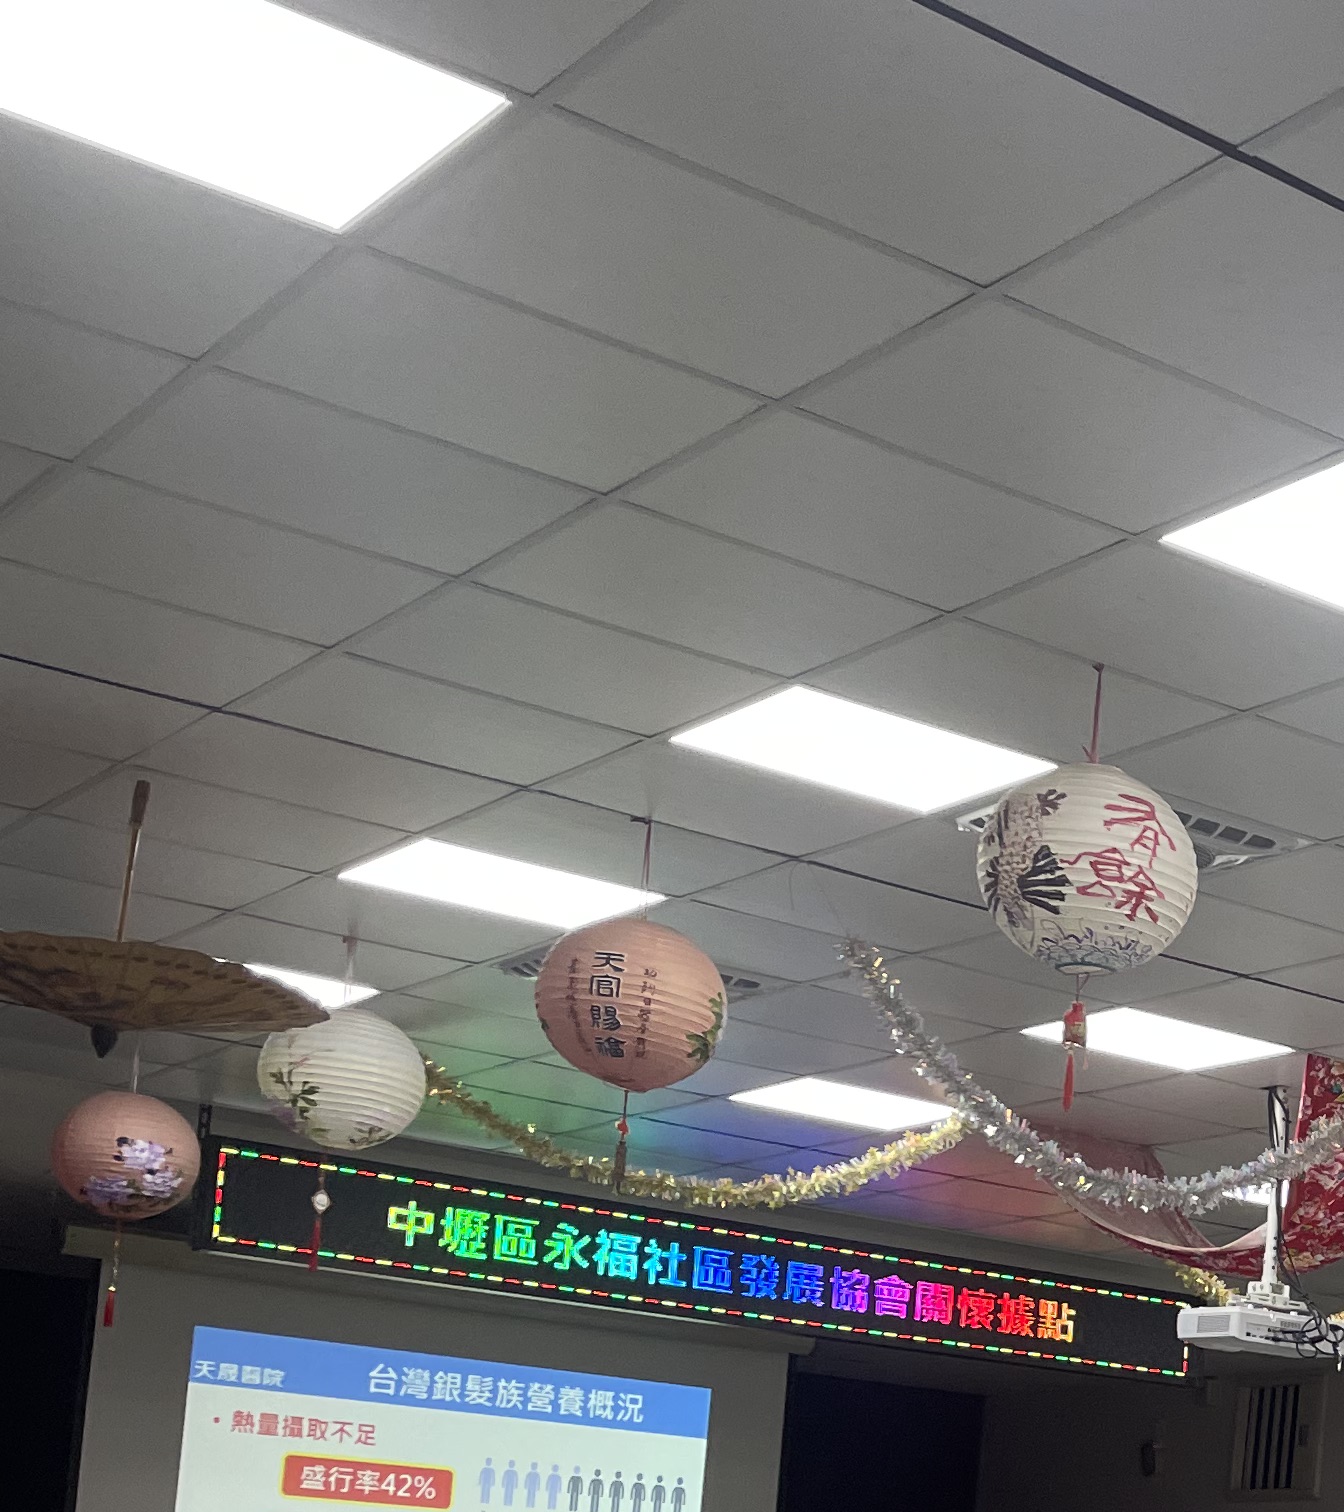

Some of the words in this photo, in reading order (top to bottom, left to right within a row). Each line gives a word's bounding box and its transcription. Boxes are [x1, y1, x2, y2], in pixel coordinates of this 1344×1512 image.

[386, 1200, 1076, 1344] 中壢區永福社區發展協會關懷據點
[368, 1363, 645, 1424] 台灣銀髮族營養概況
[230, 1410, 376, 1446] 熱量攝取不足
[299, 1464, 437, 1500] 盛行率42%
